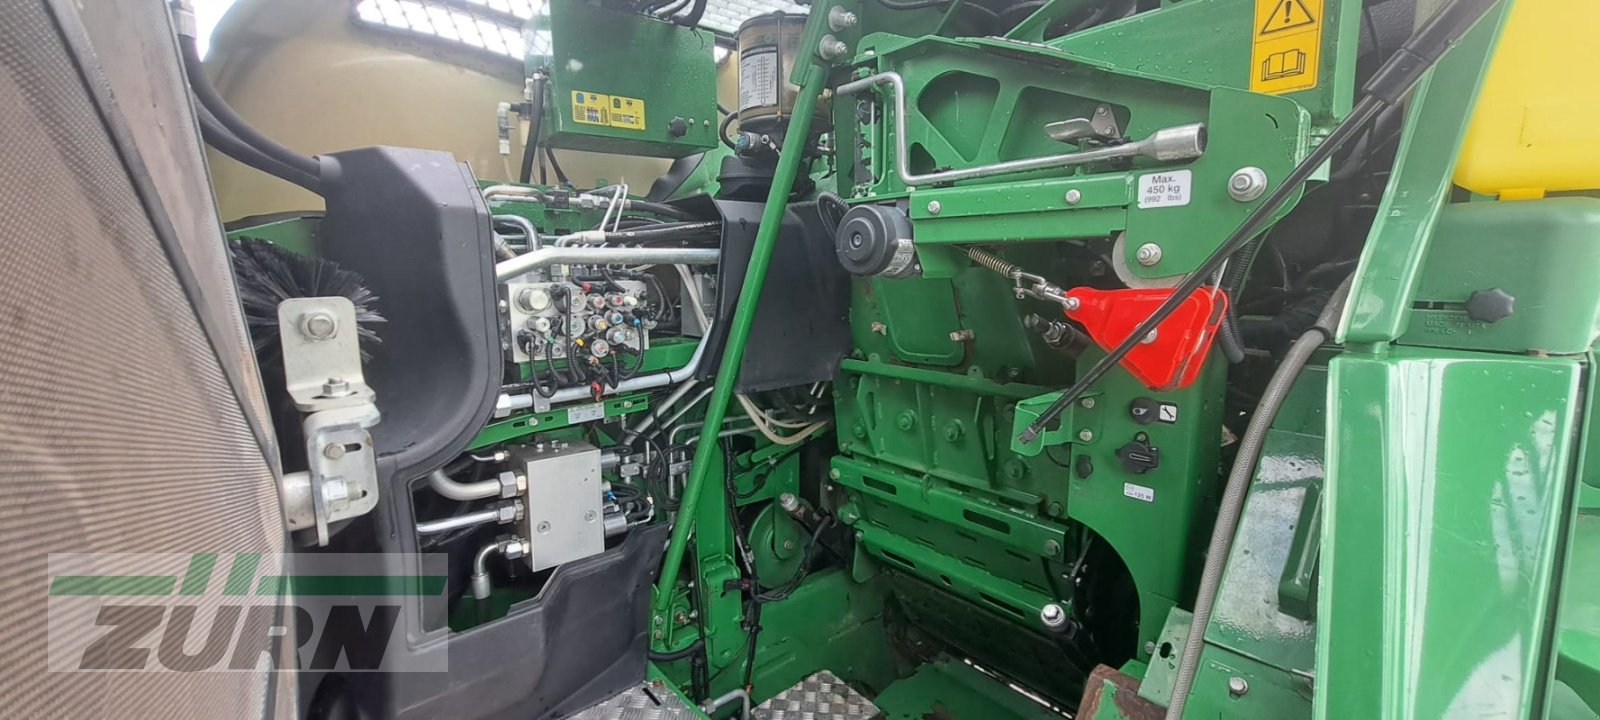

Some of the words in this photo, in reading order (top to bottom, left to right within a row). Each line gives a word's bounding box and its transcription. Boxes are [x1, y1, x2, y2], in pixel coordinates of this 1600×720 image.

[1152, 175, 1176, 184] Max.
[1147, 185, 1165, 194] 450
[1168, 184, 1181, 194] kg
[1144, 195, 1161, 204] (992
